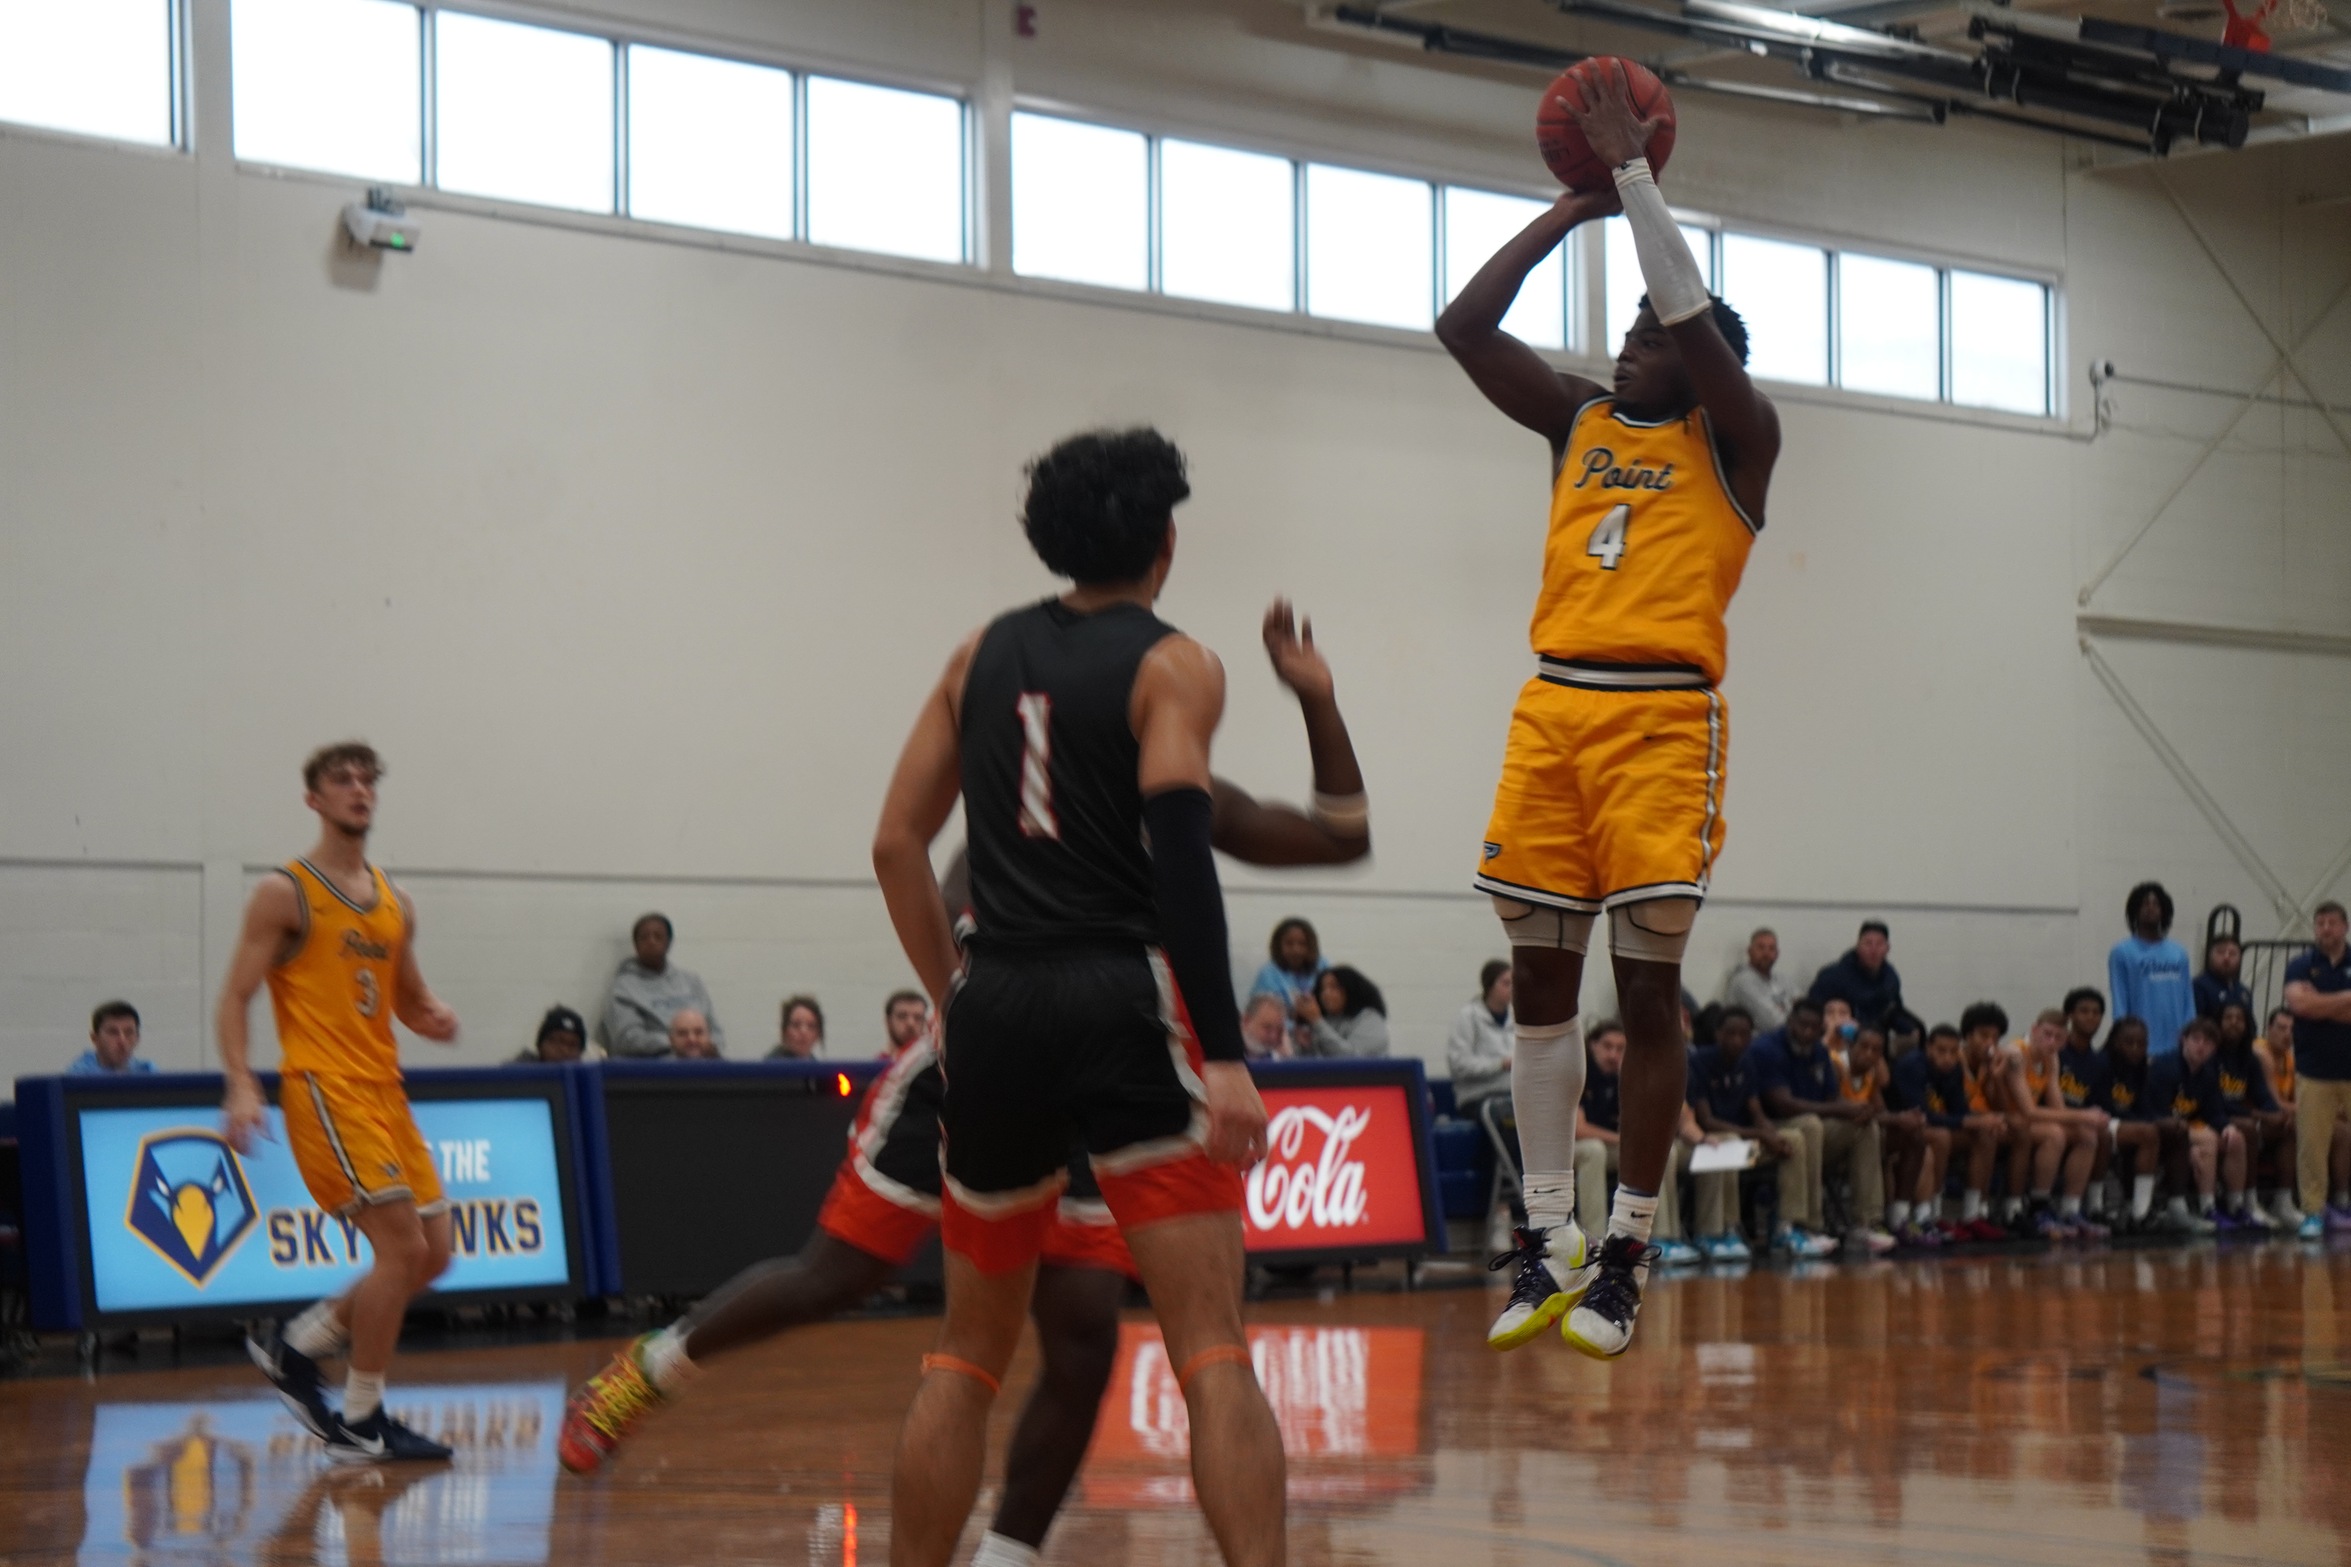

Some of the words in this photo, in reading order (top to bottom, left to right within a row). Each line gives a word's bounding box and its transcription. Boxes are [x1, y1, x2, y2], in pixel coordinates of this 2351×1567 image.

[1574, 447, 1674, 491] Point
[1585, 503, 1631, 571] 4
[1015, 688, 1061, 842] 1
[439, 1139, 492, 1182] THE
[1247, 1105, 1371, 1232] Cola
[267, 1196, 545, 1269] SKYWKS
